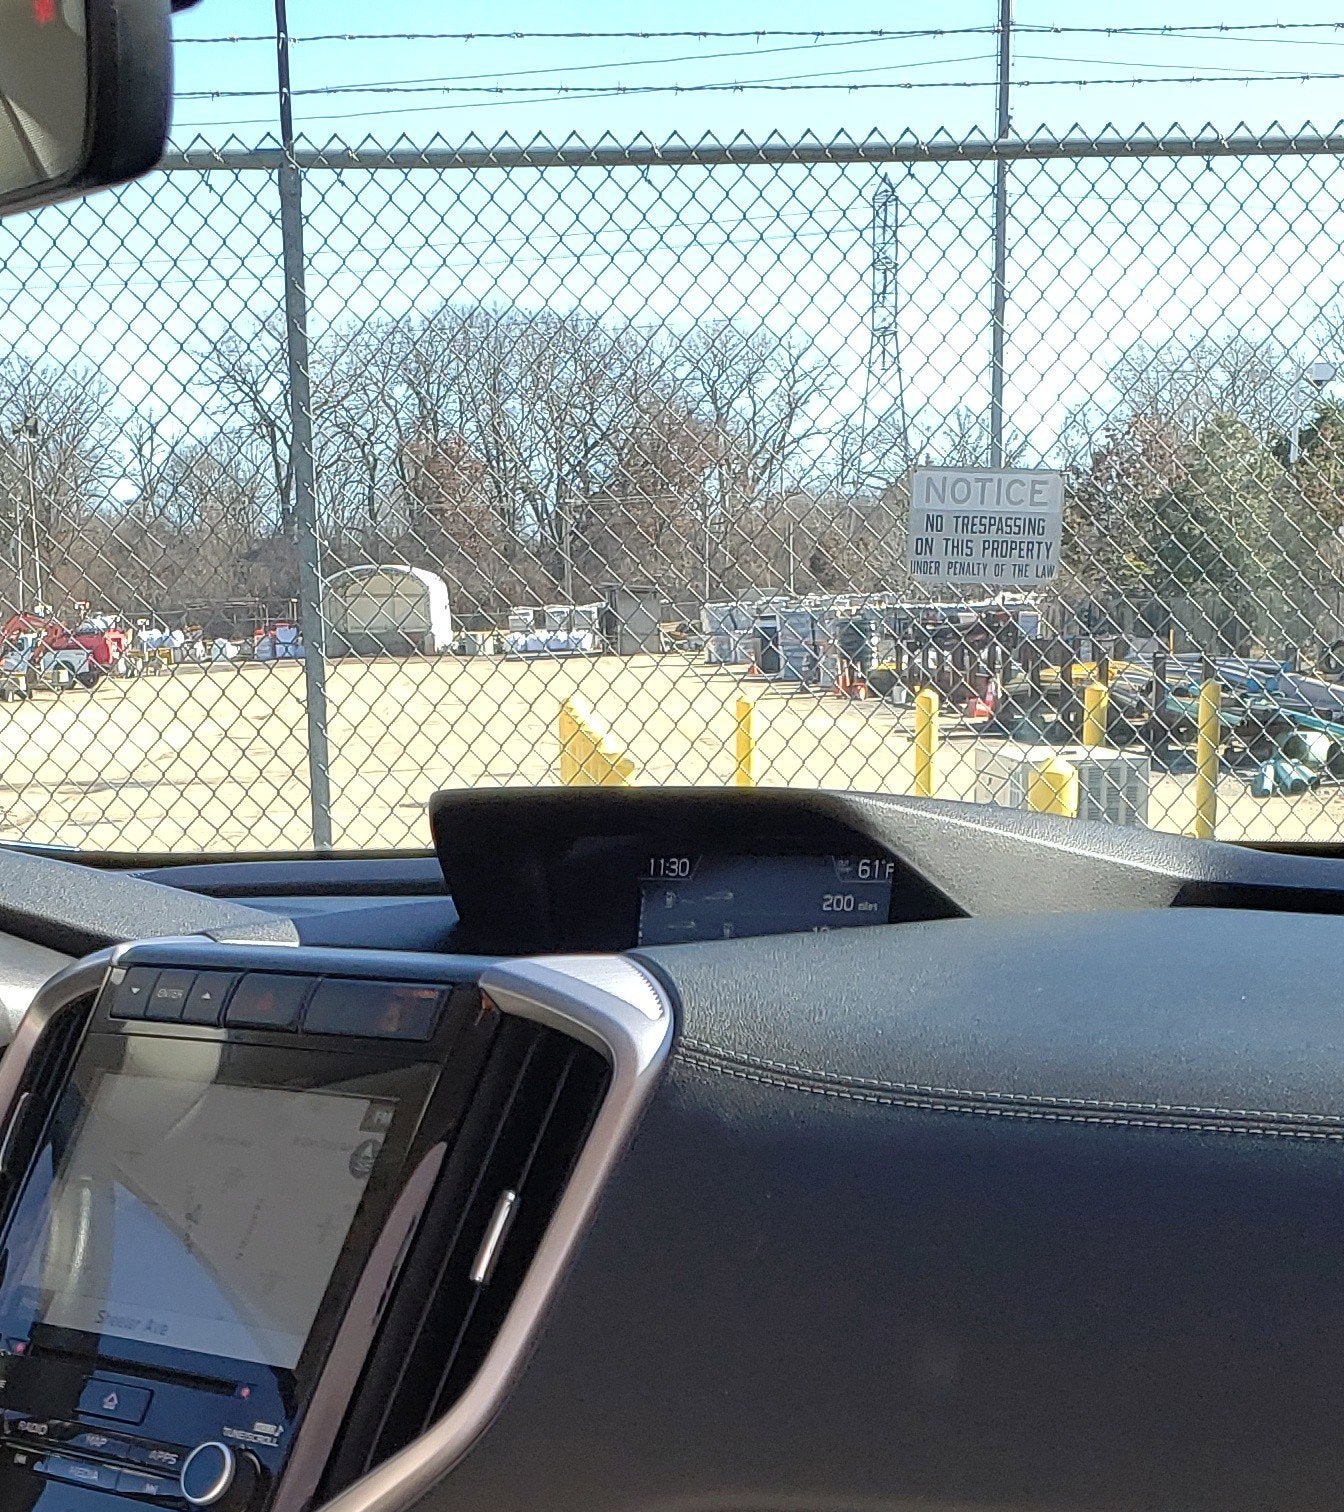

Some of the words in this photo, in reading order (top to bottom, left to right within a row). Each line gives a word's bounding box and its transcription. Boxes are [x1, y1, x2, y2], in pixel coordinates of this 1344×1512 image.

[924, 476, 1049, 507] NOTICE
[925, 514, 943, 533] NO
[953, 515, 1046, 536] TRESPASSING
[915, 538, 934, 556] ON
[943, 538, 974, 557] THIS
[981, 540, 1053, 560] PROPERTY
[910, 560, 941, 576] UNDER
[946, 561, 988, 576] PENALTY
[994, 563, 1006, 578] OF
[1011, 564, 1029, 578] THE
[1035, 565, 1056, 579] LAW
[822, 894, 855, 912] 200
[148, 1450, 179, 1465] APPS
